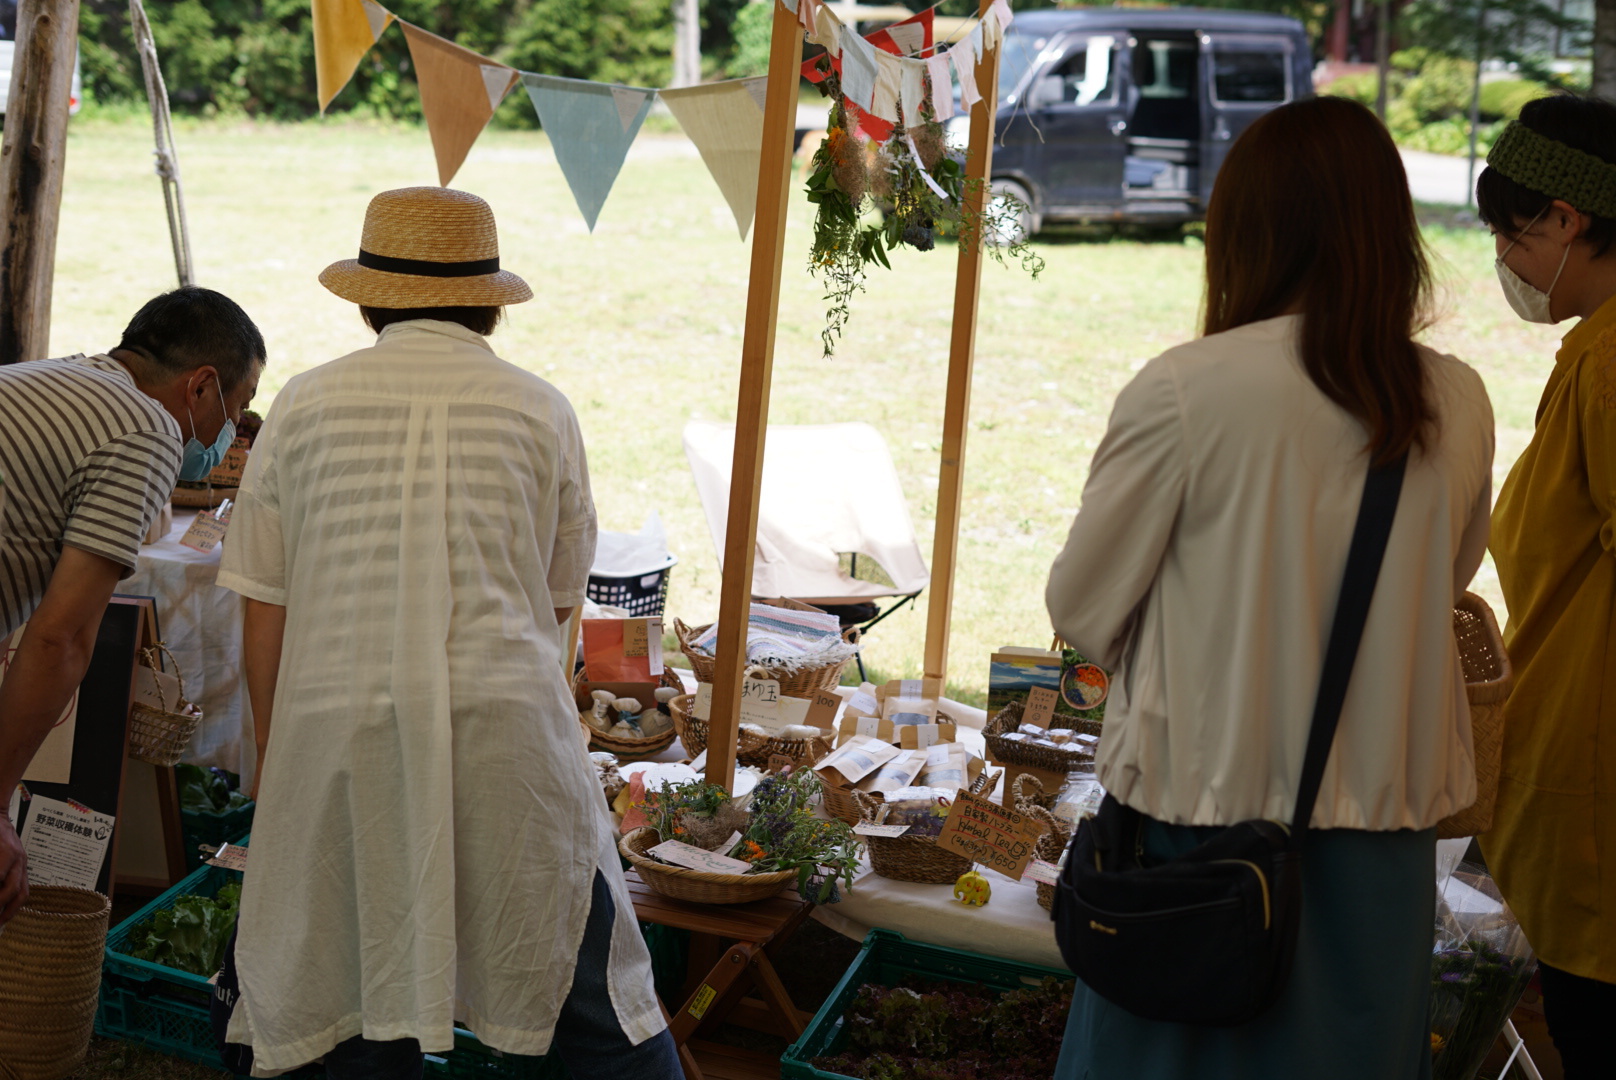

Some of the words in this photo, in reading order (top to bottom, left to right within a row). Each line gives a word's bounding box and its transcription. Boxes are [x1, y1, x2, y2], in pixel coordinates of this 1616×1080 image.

[816, 695, 835, 708] 100
[35, 813, 93, 839] 野菜収穫体験
[994, 832, 1010, 850] Tea
